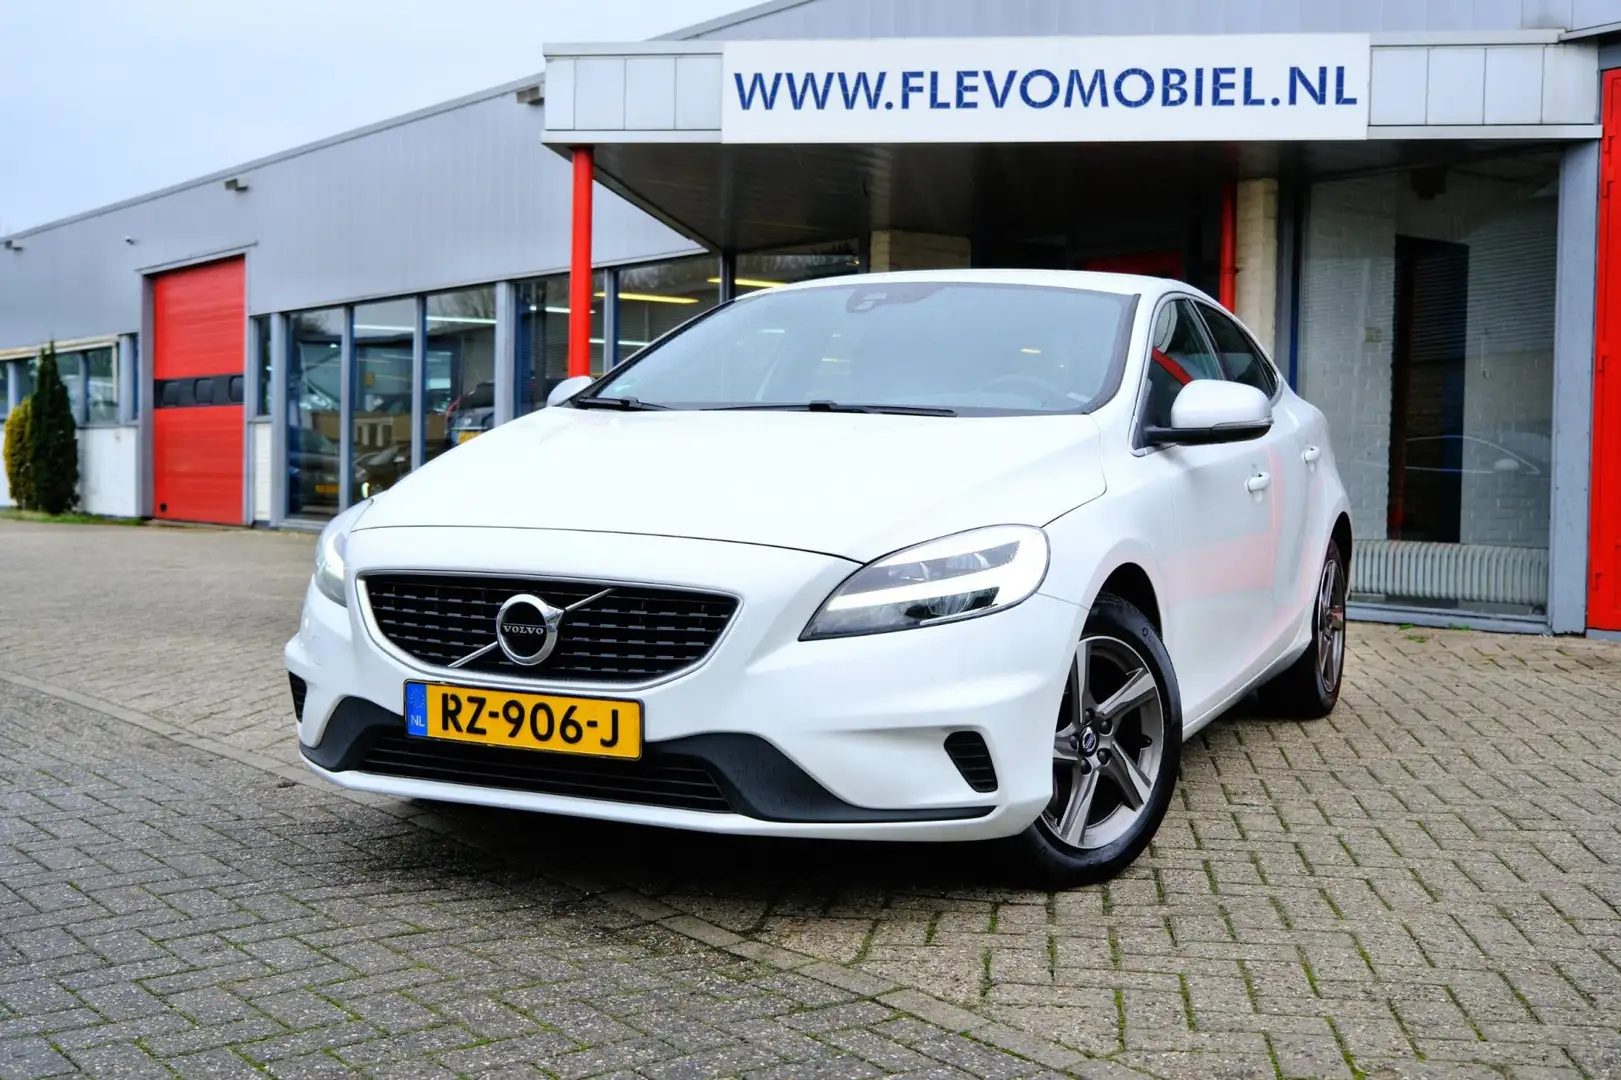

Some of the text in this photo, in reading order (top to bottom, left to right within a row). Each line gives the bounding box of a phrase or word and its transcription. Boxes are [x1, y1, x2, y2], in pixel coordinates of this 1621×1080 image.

[734, 65, 1357, 110] WWW.FLEVOMOBIEL.NL
[503, 625, 544, 635] VOLVO
[410, 714, 425, 727] NL
[441, 692, 619, 748] RZ-906-J
